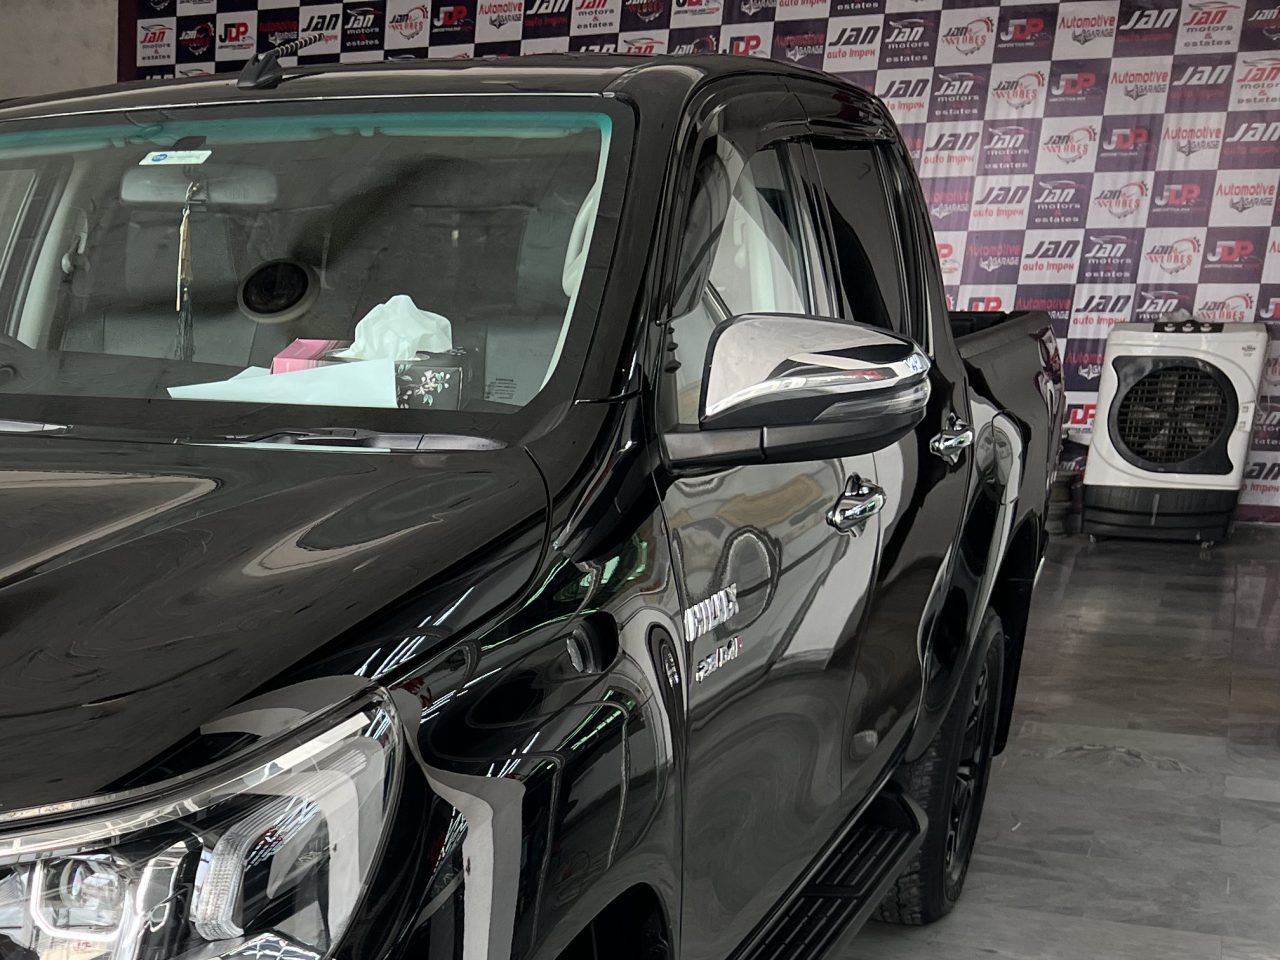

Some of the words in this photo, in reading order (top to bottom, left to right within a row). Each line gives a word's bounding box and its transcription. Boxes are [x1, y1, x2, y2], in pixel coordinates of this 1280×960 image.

[479, 2, 523, 15] Automotive
[1059, 15, 1116, 29] Automotive
[1111, 70, 1169, 85] Automotive
[1163, 126, 1222, 141] Automotive
[1216, 182, 1276, 197] Automotive
